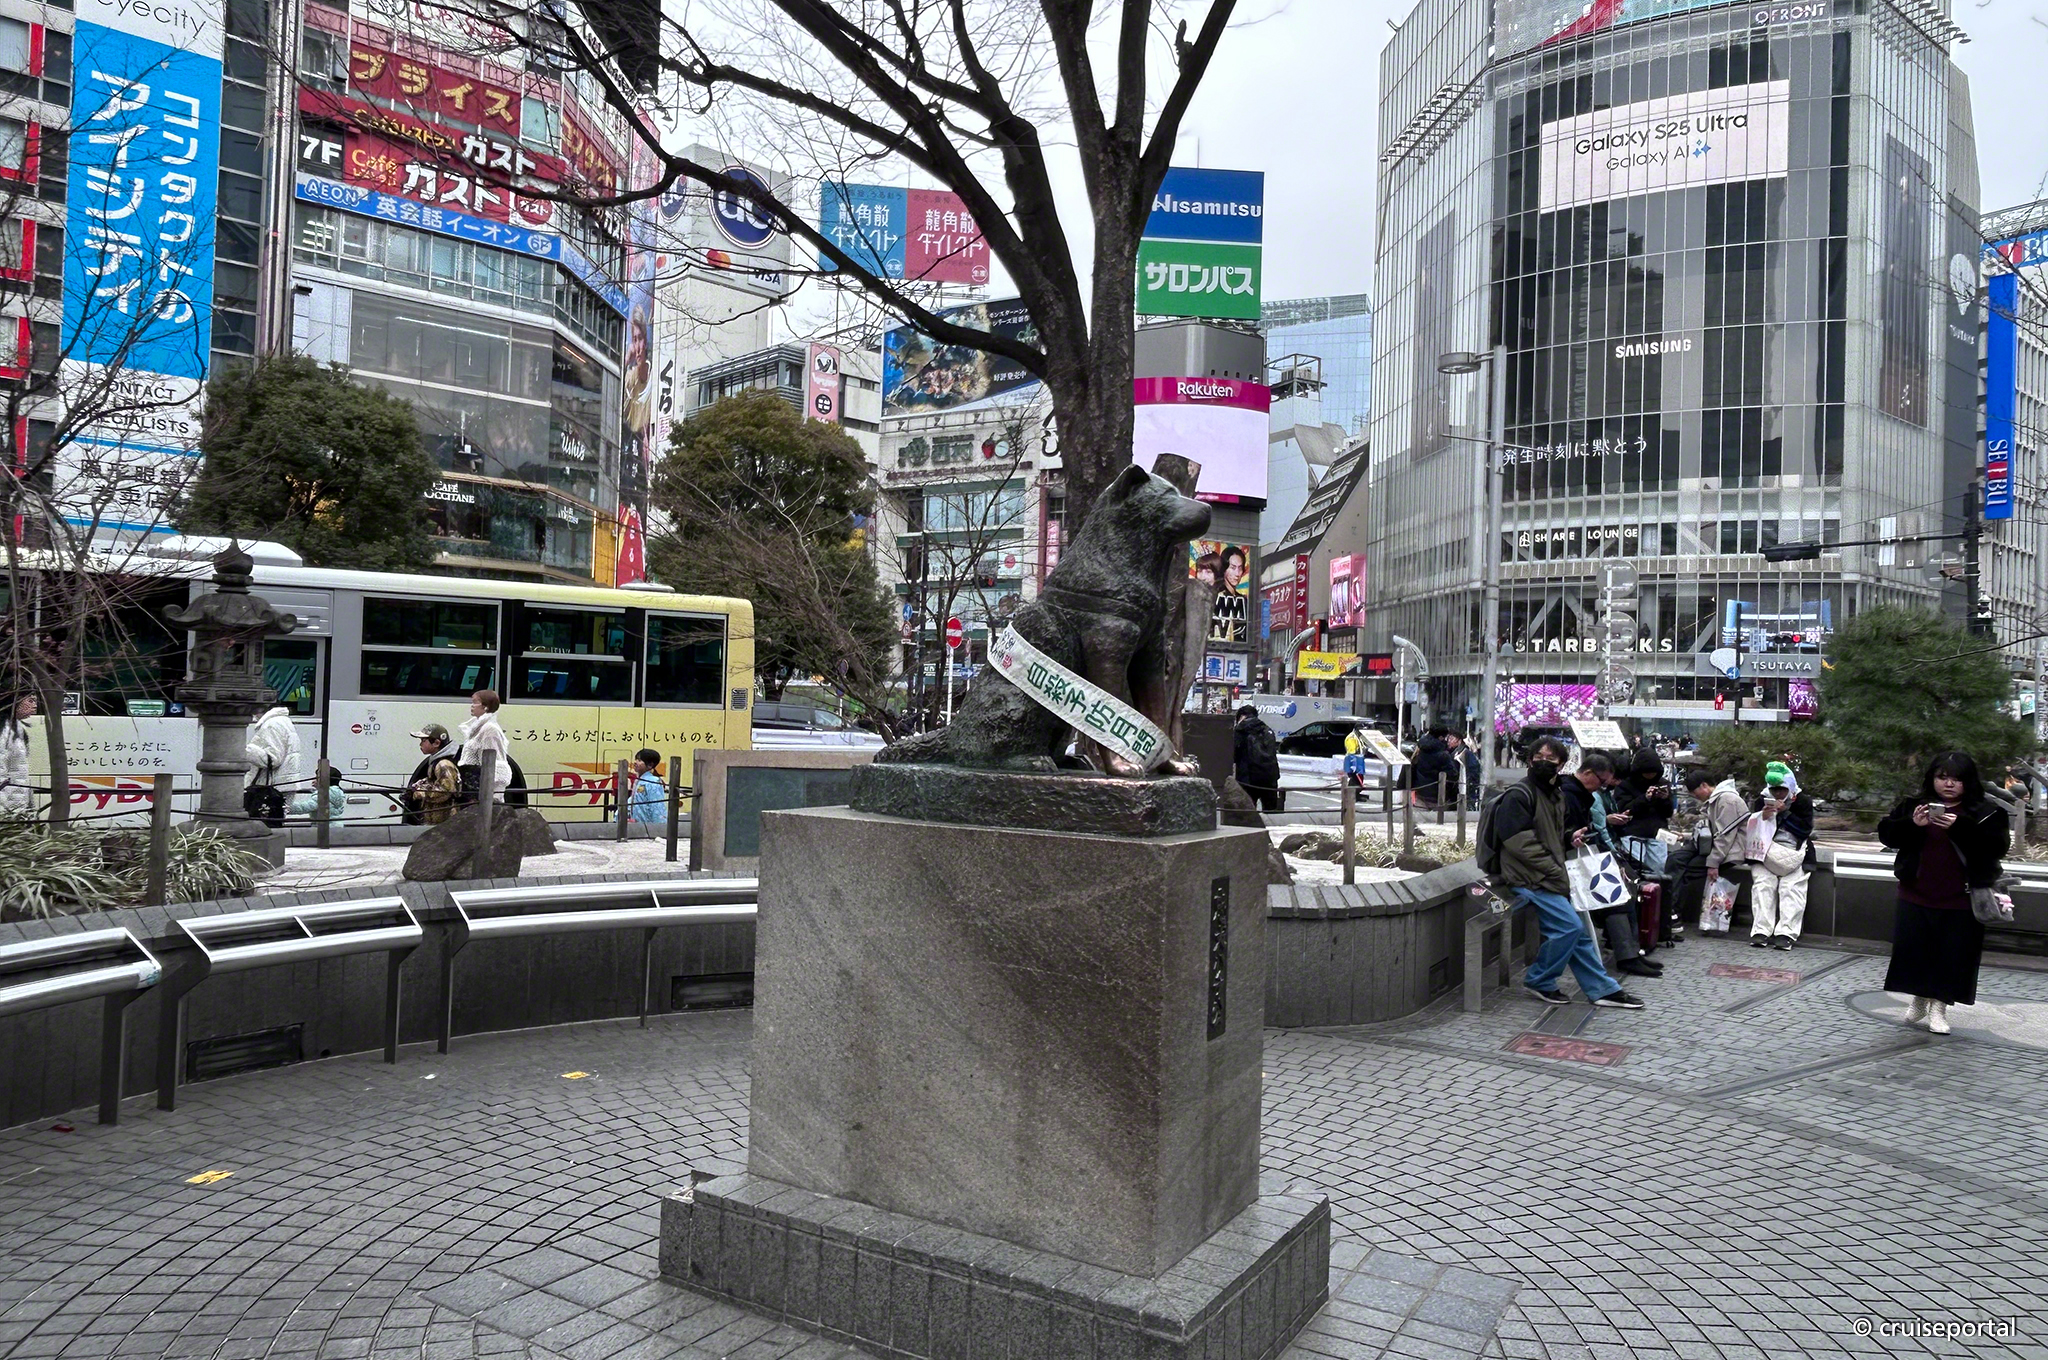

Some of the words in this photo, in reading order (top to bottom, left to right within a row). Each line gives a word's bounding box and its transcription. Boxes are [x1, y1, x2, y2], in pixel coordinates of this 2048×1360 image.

[98, 0, 206, 39] yecity
[1755, 3, 1826, 24] QFRONT
[352, 50, 516, 123] プライス
[1575, 128, 1649, 155] Galaxy
[1655, 119, 1691, 140] S25
[1696, 113, 1748, 134] Ultra
[300, 136, 343, 168] 7F
[462, 134, 536, 175] ガスト
[1606, 149, 1668, 171] Galaxy
[1674, 145, 1690, 159] AI
[402, 160, 502, 212] ガスト
[305, 180, 358, 205] AEON
[376, 196, 443, 229] 英会話
[446, 213, 520, 245] イーオン
[839, 204, 890, 228] 龍角散
[925, 209, 975, 234] 龍角散
[917, 233, 984, 258] ダイレクト
[1145, 262, 1254, 297] サロンパス
[1615, 339, 1692, 359] SAMSUNG
[100, 378, 176, 400] ONTACT
[1177, 381, 1234, 400] Rakuten
[1503, 437, 1647, 466] 発生時刻に黙とう
[1987, 439, 2008, 505] SEIBU
[1534, 530, 1575, 542] SHARE
[1587, 528, 1638, 541] LOUNGE
[1514, 638, 1673, 653] STARBKS
[1752, 661, 1812, 671] TSUTAYA
[502, 729, 718, 745] ころとからだに、おいしいものを。
[67, 757, 166, 767] おいしいものを。
